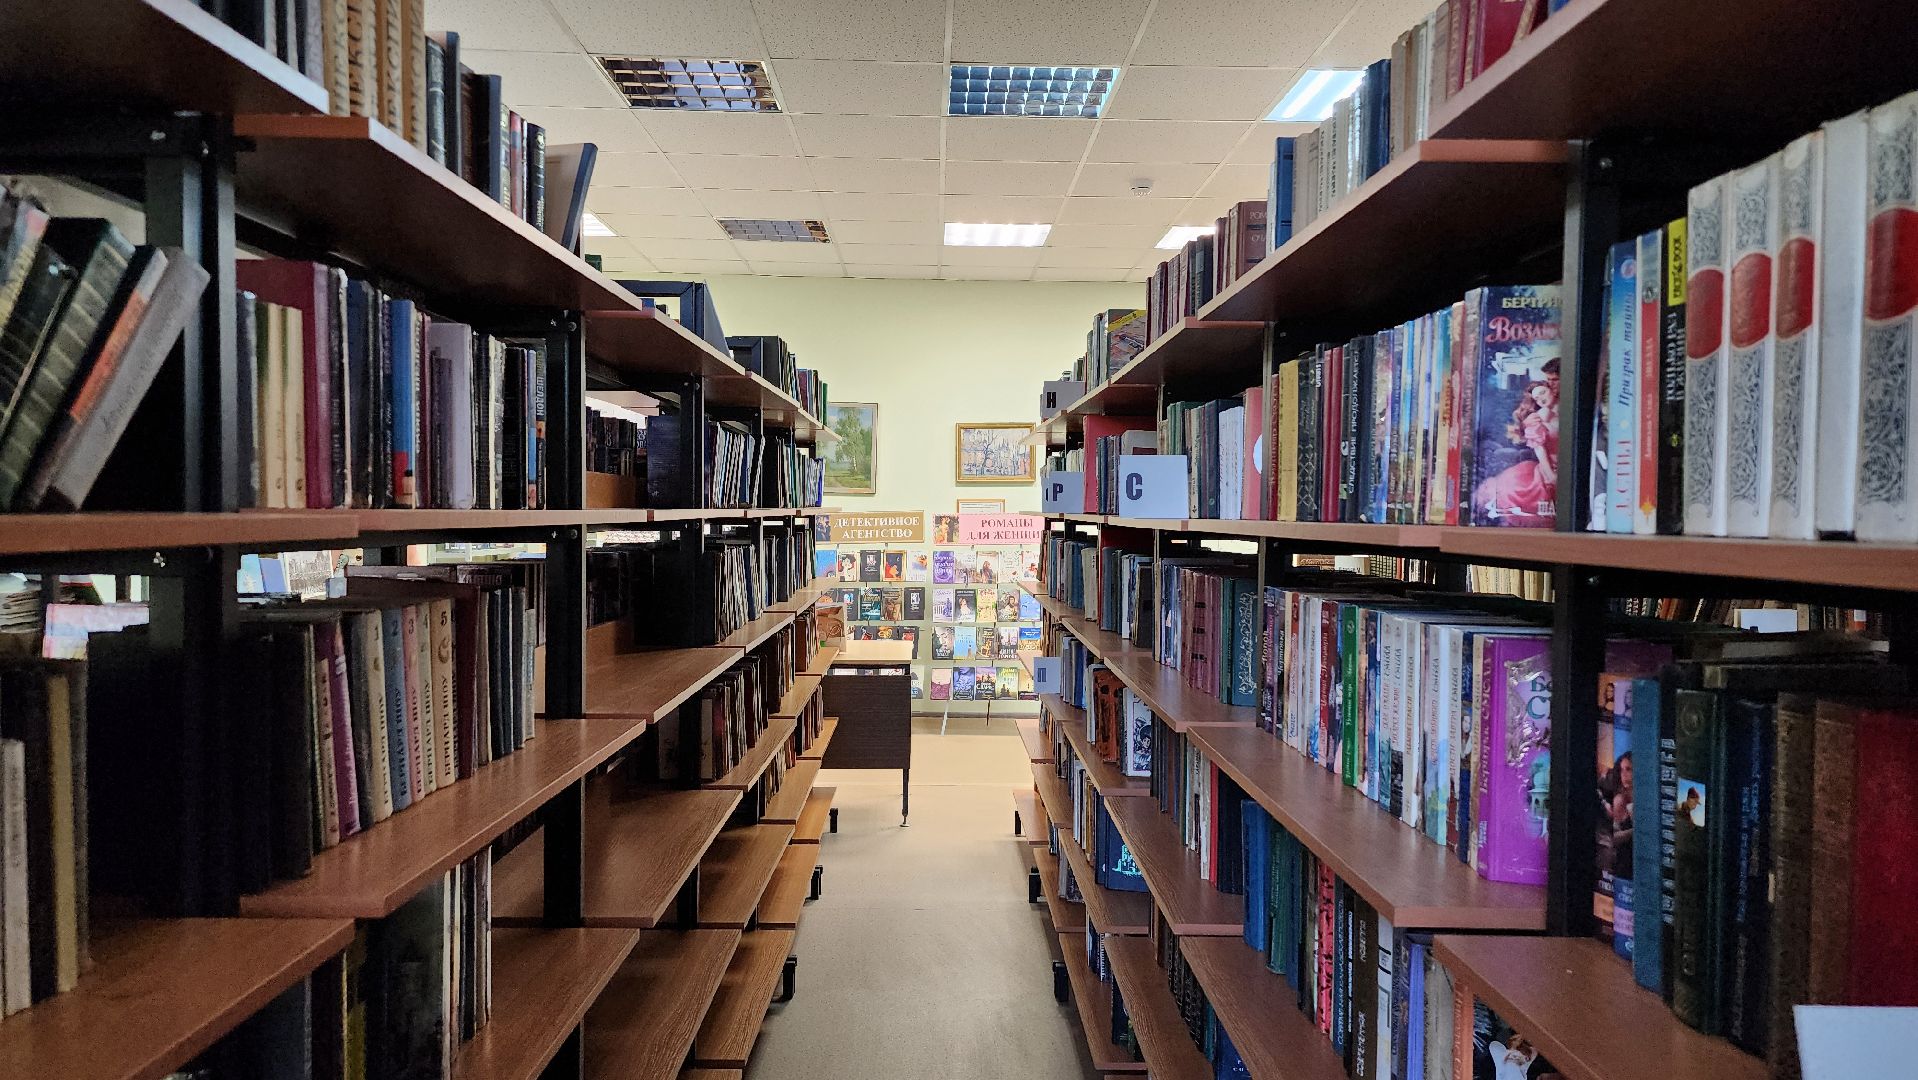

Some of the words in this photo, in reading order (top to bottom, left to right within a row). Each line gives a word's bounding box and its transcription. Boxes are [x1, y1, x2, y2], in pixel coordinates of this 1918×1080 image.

[1618, 349, 1634, 406] Призрак
[535, 376, 545, 416] ШЕЛДОН
[1046, 392, 1057, 408] Н
[1347, 436, 1356, 493] СЛЕДСТВИЕ
[1053, 483, 1064, 501] Р
[1126, 473, 1143, 500] С
[834, 516, 920, 529] ДЕТЕКТИВНОЕ
[981, 519, 1033, 528] РОМАНЫ
[842, 529, 913, 539] АГЕНТСТВО
[966, 530, 990, 541] ДЛЯ
[992, 530, 1040, 540] ЖЕНЩИ
[439, 610, 447, 625] 5
[407, 618, 414, 634] 3
